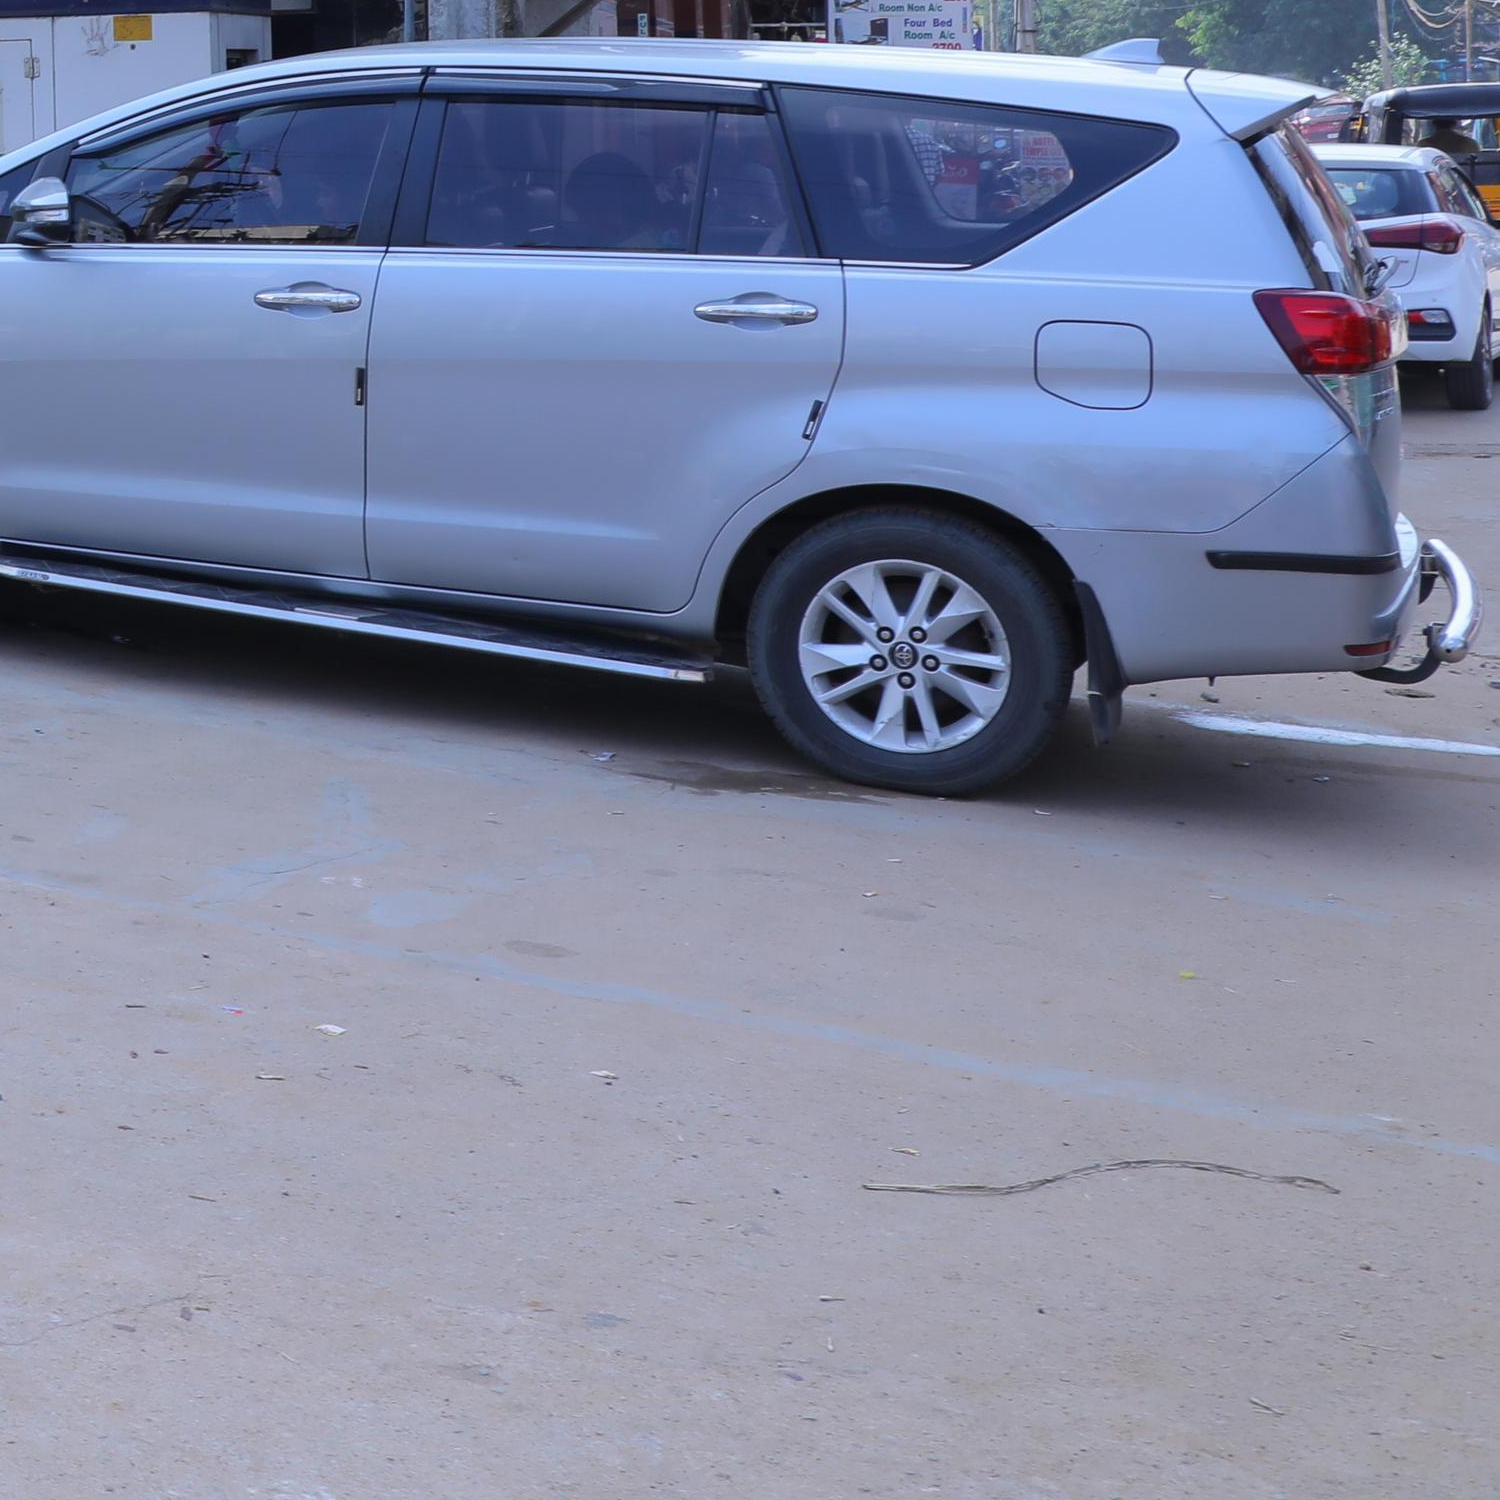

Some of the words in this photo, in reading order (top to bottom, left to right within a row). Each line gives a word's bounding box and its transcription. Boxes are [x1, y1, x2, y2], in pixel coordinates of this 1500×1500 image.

[879, 3, 905, 12] Room
[907, 3, 926, 12] Non
[904, 18, 927, 28] Four
[933, 18, 953, 27] Bed
[904, 30, 933, 40] Room
